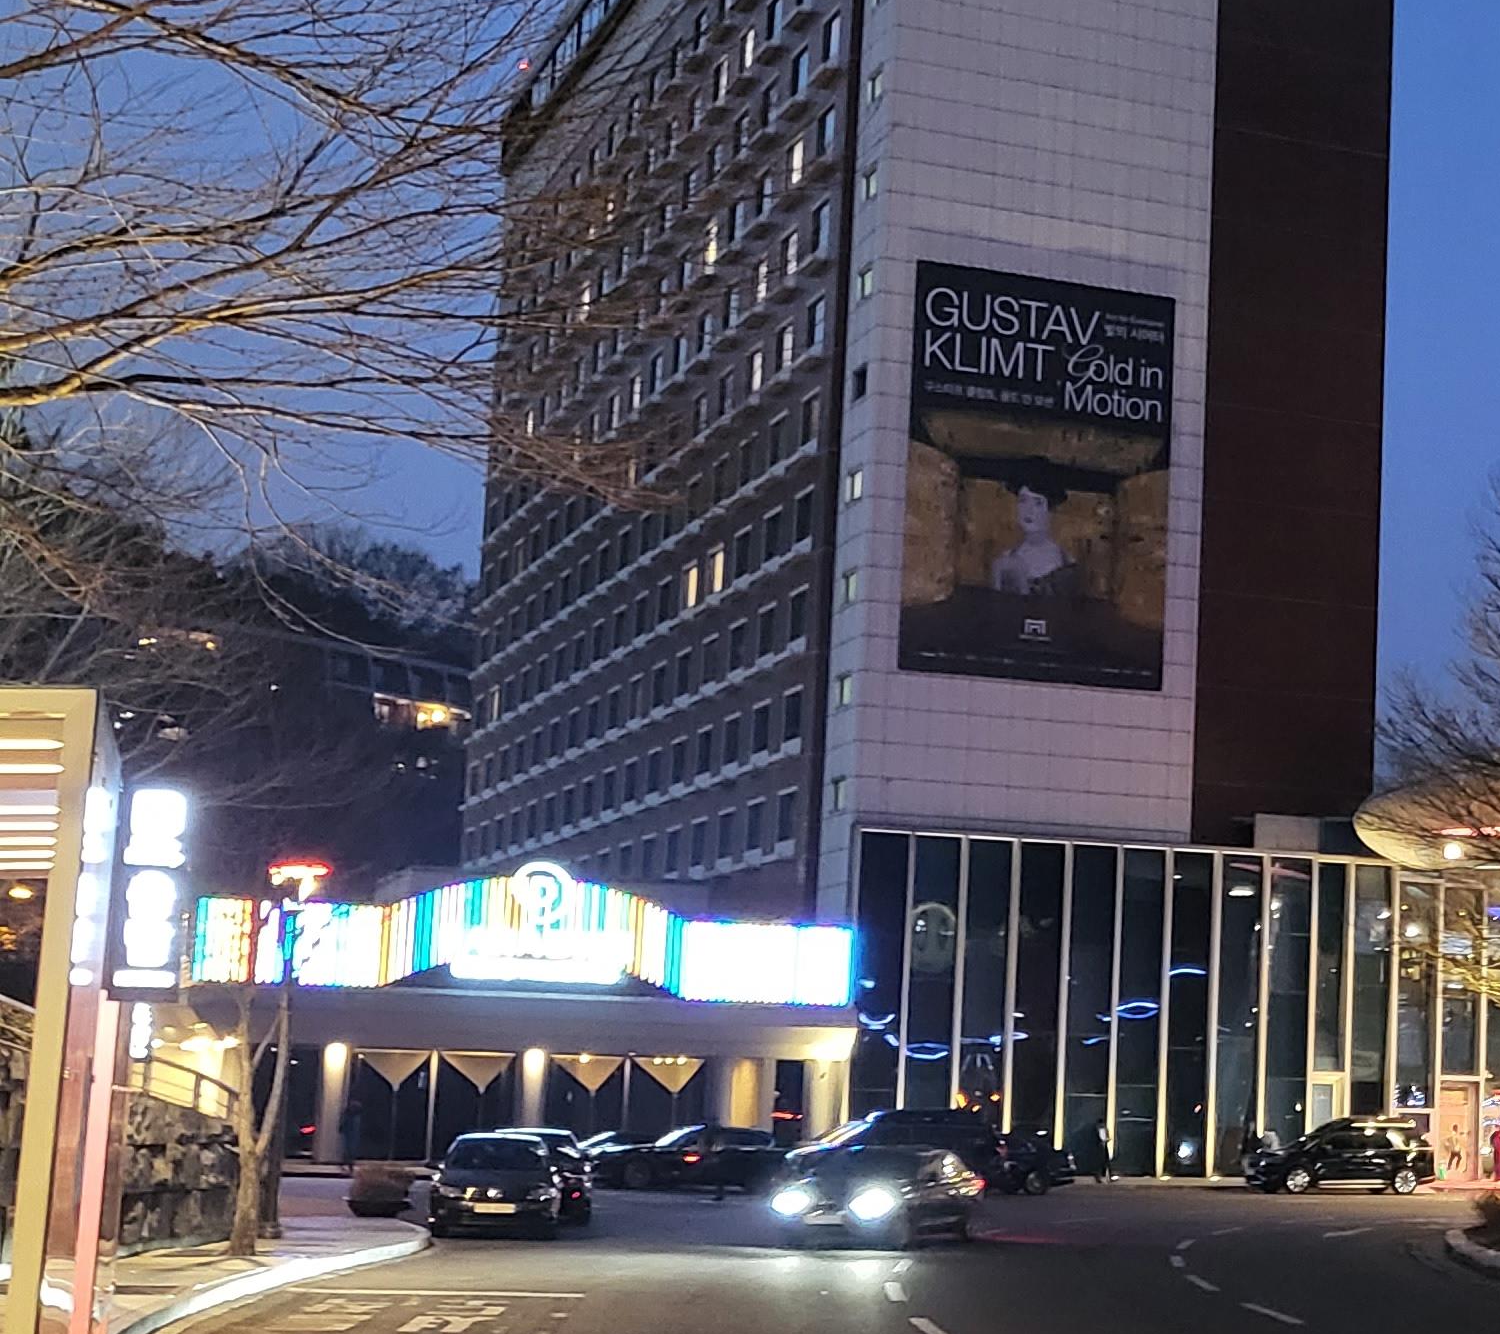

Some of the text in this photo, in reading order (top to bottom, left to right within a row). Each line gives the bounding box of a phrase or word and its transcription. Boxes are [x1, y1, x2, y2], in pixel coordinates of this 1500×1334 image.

[925, 287, 1100, 345] GUSTAV
[923, 329, 1055, 382] KLIMT
[1064, 344, 1163, 390] Gold in
[1063, 381, 1162, 423] Motion
